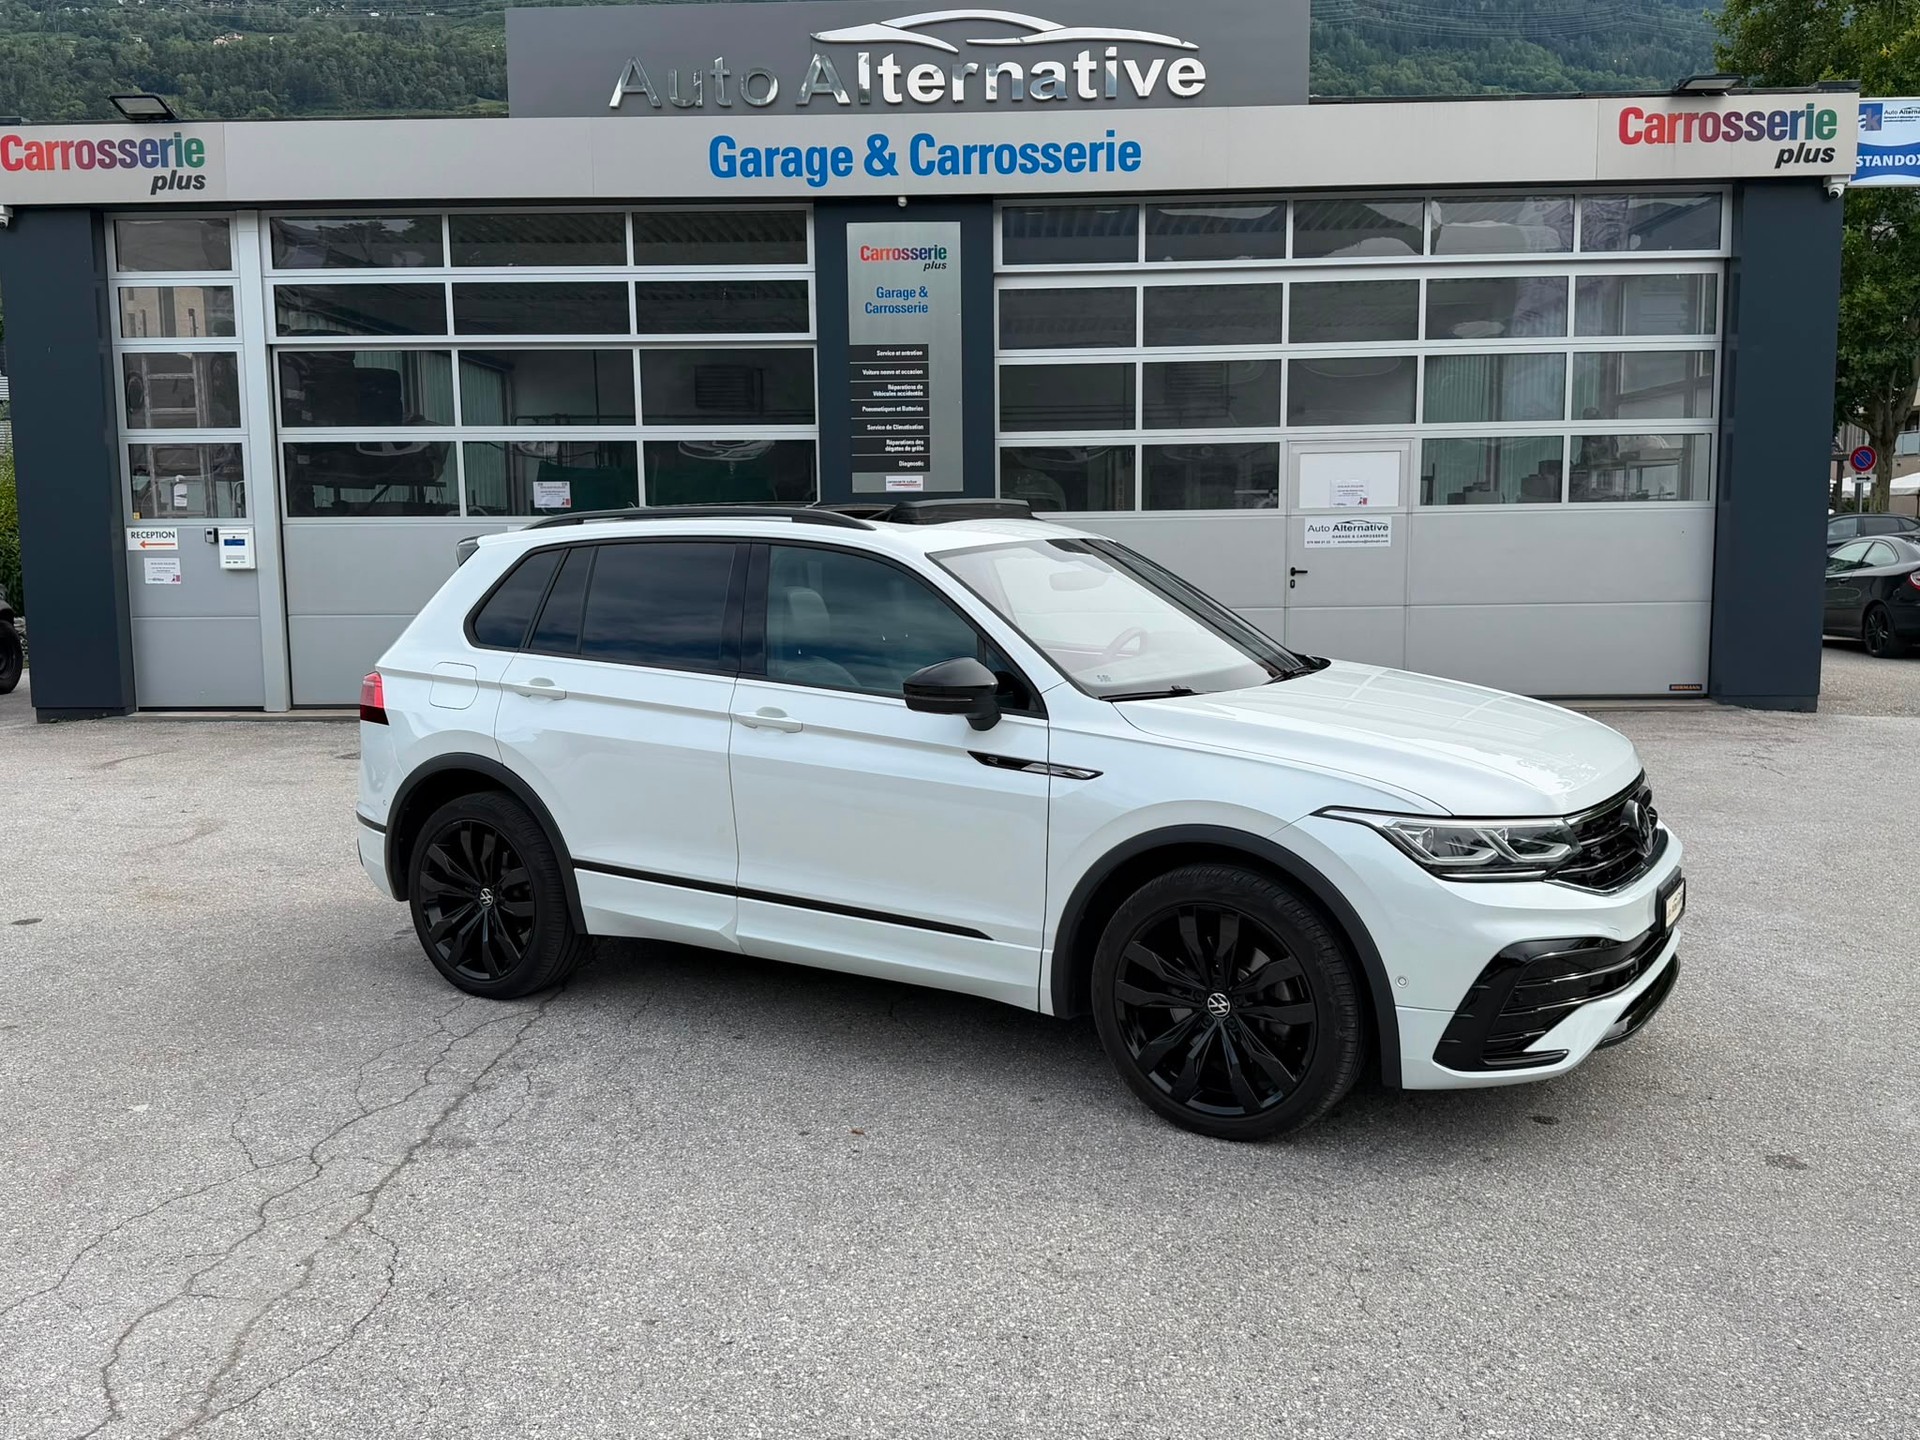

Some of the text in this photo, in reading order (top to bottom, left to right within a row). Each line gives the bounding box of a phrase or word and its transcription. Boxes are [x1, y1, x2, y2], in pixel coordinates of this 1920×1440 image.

[608, 46, 1207, 108] Auto Alternative
[1618, 103, 1838, 145] Carrosserie
[0, 132, 205, 171] Carrosserie
[709, 129, 1142, 188] Garage & Carrosserie
[1774, 142, 1836, 169] plus
[150, 170, 207, 195] plus
[860, 245, 947, 261] Carrosserie
[923, 261, 947, 272] plus
[876, 286, 928, 300] Garage &
[865, 302, 929, 314] Carrosserie
[130, 531, 176, 539] RECEPTION
[1307, 523, 1389, 532] Auto Alternative
